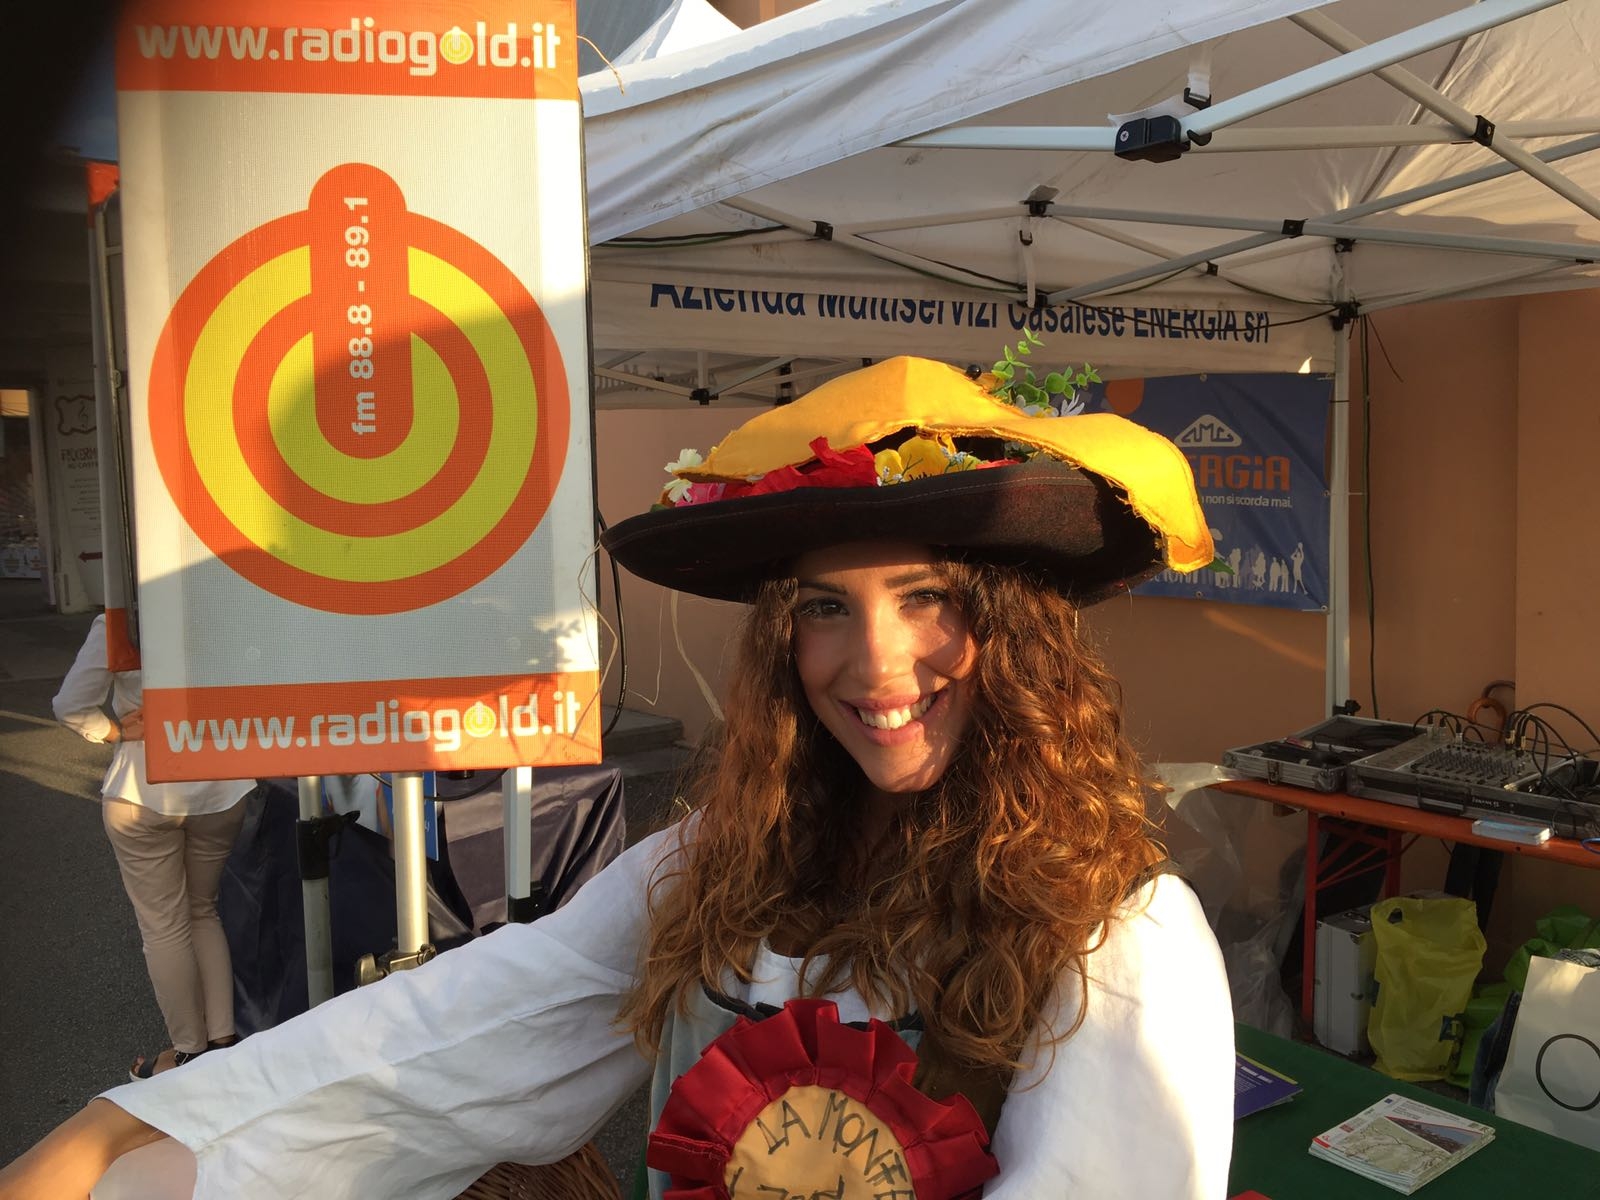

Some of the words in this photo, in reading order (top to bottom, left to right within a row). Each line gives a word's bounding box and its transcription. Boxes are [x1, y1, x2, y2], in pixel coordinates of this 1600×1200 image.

[135, 17, 562, 77] www.radiogold.it
[343, 196, 371, 269] 89.1
[347, 303, 374, 380] 88.8
[1133, 306, 1240, 343] ENERGIA
[351, 391, 376, 436] fm
[163, 690, 581, 753] www.radiogold.it
[756, 1100, 812, 1156] LA
